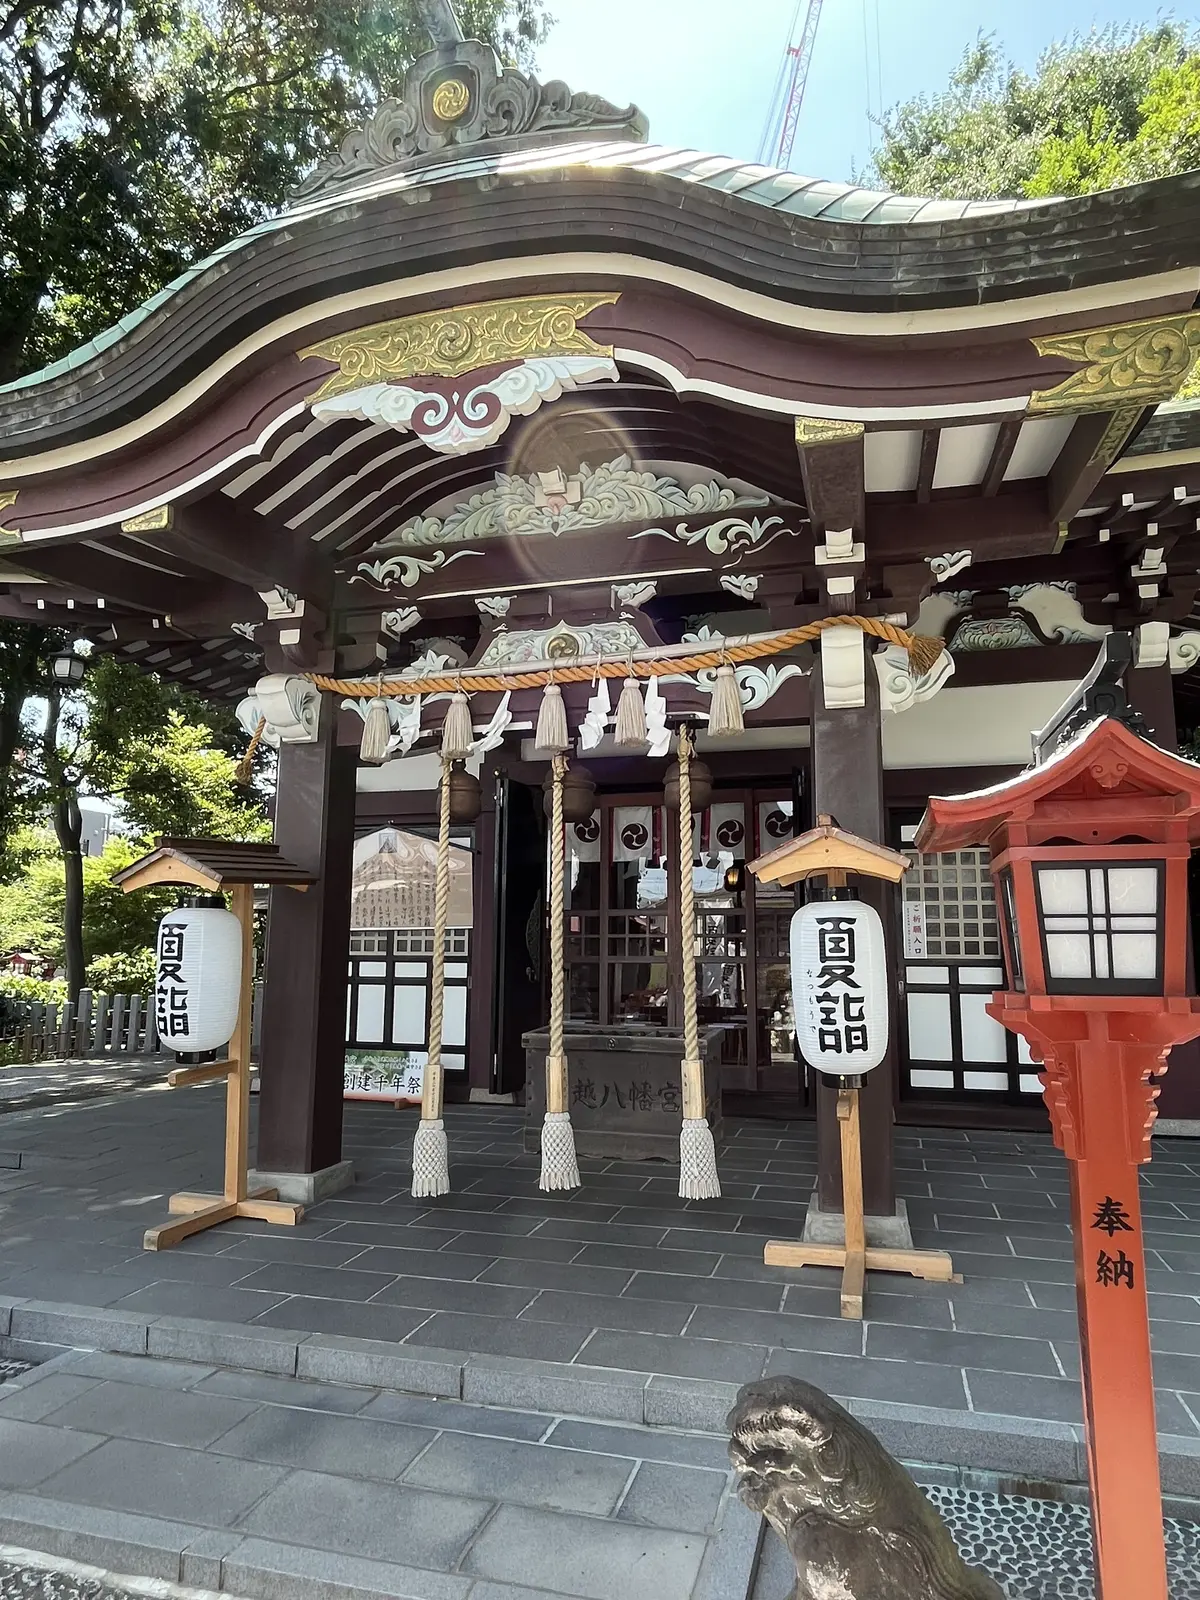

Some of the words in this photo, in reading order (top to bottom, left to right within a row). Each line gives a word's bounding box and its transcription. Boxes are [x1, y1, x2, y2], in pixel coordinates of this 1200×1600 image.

[912, 903, 922, 954] ご祈願入口
[157, 923, 190, 1037] 夏詣
[806, 968, 817, 1034] なつもうで
[815, 917, 869, 1054] 夏詣
[343, 1073, 421, 1095] 創建千年祭
[1090, 1195, 1135, 1290] 奉納
